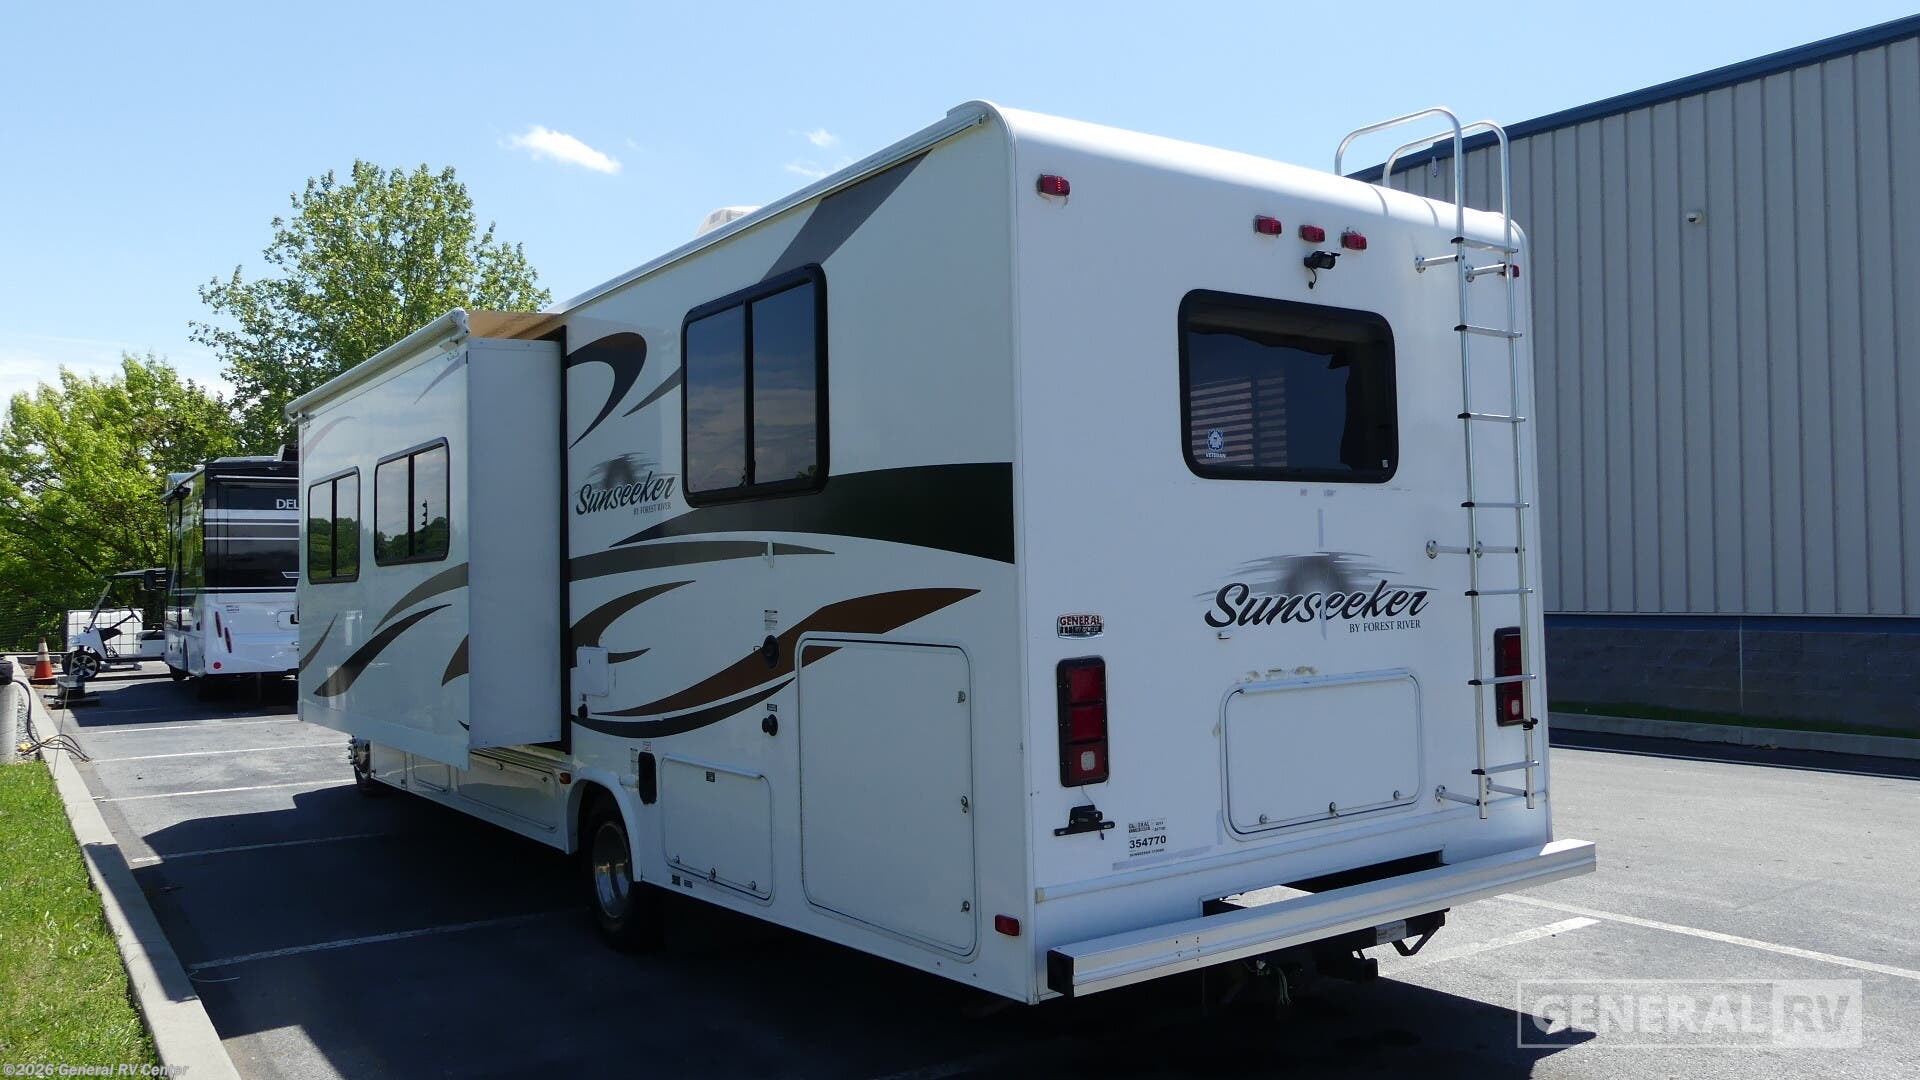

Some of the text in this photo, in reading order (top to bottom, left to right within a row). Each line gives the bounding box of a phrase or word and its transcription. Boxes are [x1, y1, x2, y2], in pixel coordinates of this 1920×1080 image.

[576, 470, 676, 516] Sunseeker
[1204, 579, 1429, 628] Sunseeker
[1060, 615, 1101, 626] GENERAL
[1349, 619, 1422, 633] BY FOREST RIVER
[1129, 834, 1167, 849] 354770
